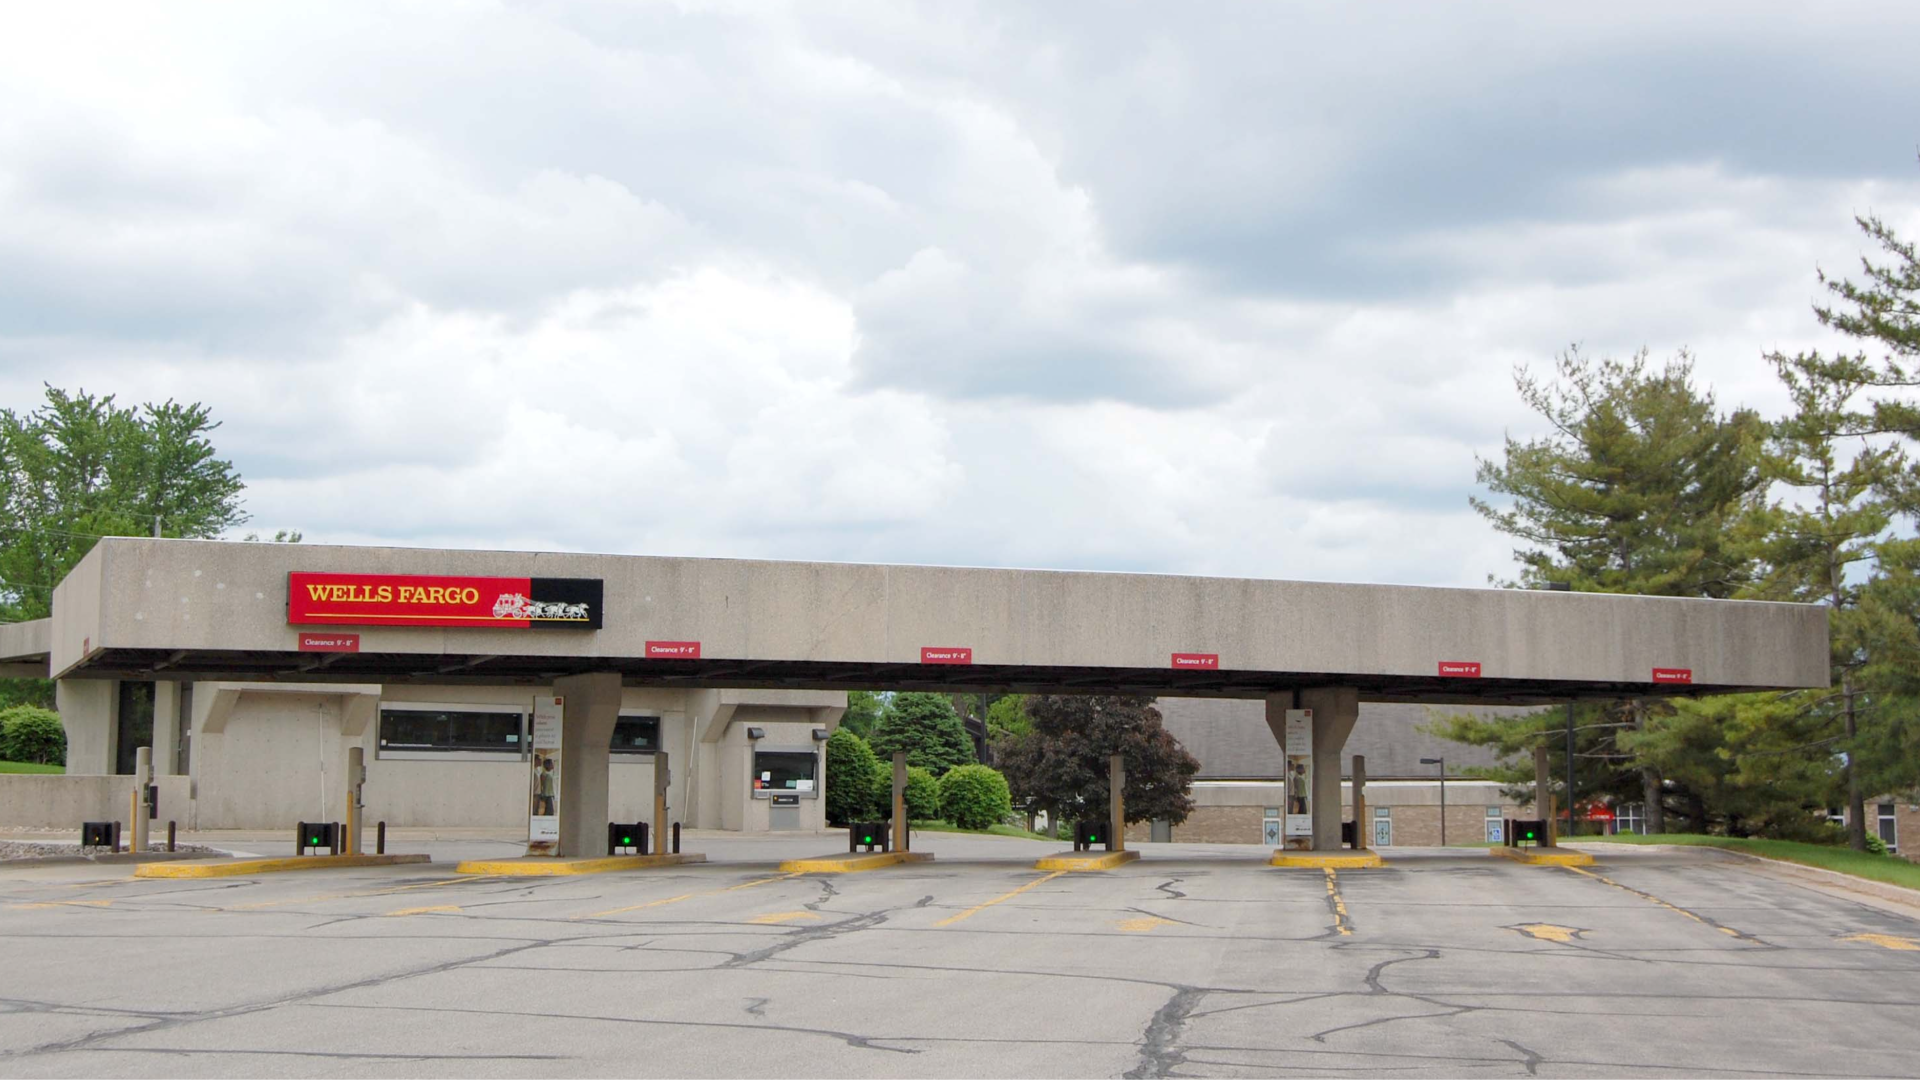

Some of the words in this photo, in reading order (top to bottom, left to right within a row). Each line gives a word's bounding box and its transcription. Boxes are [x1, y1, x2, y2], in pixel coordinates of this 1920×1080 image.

[306, 584, 392, 602] WELLS
[397, 586, 479, 604] FARGO
[304, 638, 335, 646] Clearance
[650, 645, 678, 653] Clearance
[926, 651, 952, 659] Clearance
[1176, 657, 1200, 665] Clearance
